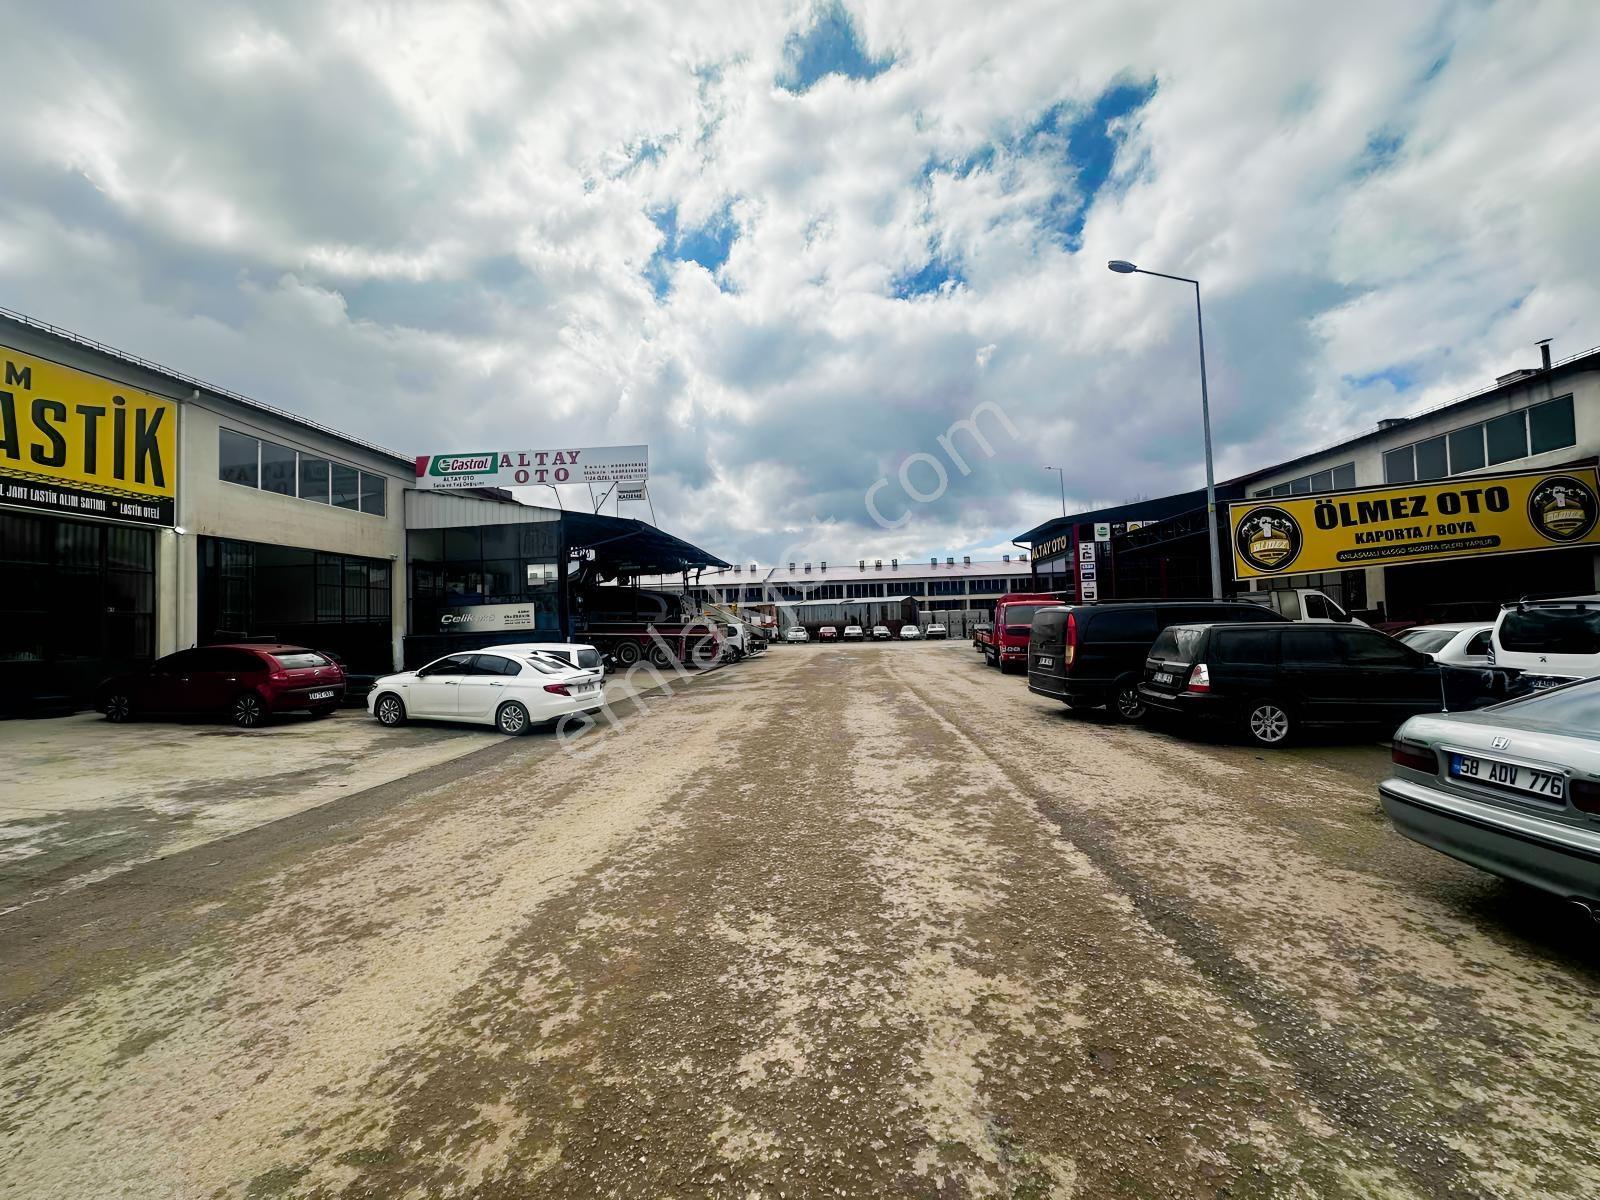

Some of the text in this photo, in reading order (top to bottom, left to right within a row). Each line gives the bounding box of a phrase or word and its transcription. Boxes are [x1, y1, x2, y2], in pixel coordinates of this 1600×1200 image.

[451, 458, 489, 471] Castrol
[499, 451, 581, 468] ALTAY
[514, 467, 570, 484] OTO
[1314, 486, 1510, 530] ÖLMEZ OTO
[1355, 525, 1424, 544] KAPORTA
[1437, 521, 1477, 535] BOYA
[1052, 535, 1067, 553] OTO
[1461, 756, 1563, 796] 58 ADV 776
